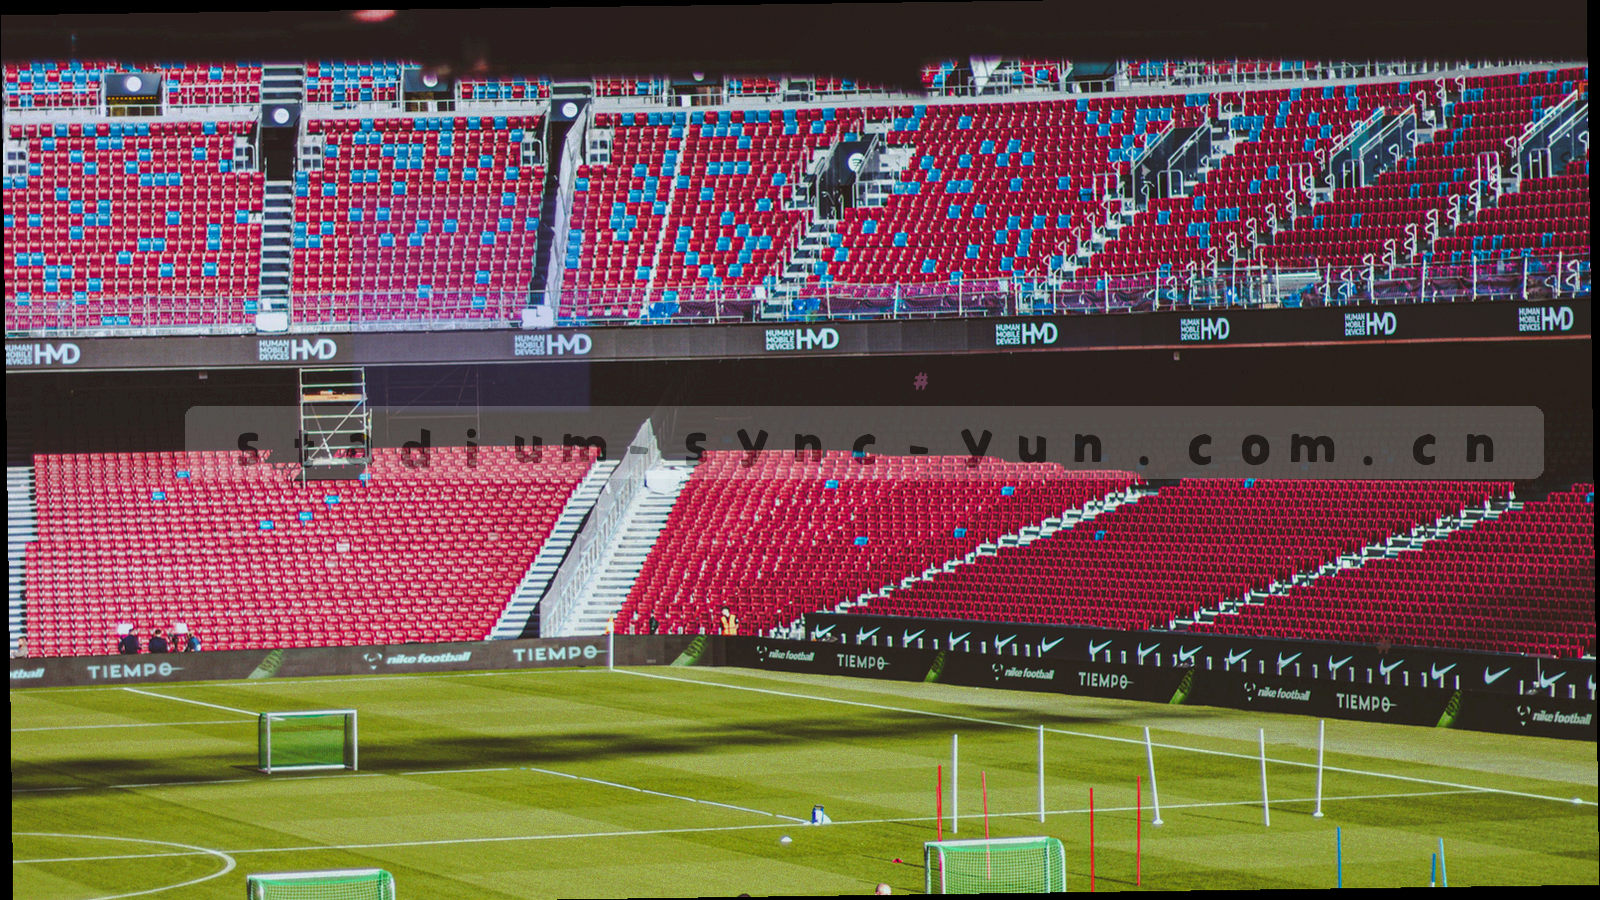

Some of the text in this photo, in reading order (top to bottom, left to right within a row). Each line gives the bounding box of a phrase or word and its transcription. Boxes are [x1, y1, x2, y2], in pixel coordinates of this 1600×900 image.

[1519, 307, 1540, 315] HUMAN
[1519, 315, 1540, 323] MOBILE
[1541, 306, 1574, 331] HMD
[1200, 317, 1231, 340] HMD
[1366, 311, 1398, 335] HMD
[1519, 323, 1541, 331] DEVICES
[796, 327, 840, 350] HMD
[1021, 322, 1059, 344] HMD
[291, 338, 337, 360] HMD
[514, 348, 545, 356] DEVICES
[546, 333, 592, 355] HMD
[765, 343, 795, 351] DEVICES
[34, 343, 81, 365] HMD
[386, 651, 472, 665] nike football
[512, 645, 605, 662] TIEMPO
[768, 649, 815, 662] nike football
[87, 662, 180, 680] TIEMPO
[837, 654, 889, 671] TIEMPO
[1004, 667, 1055, 680] nike football
[1078, 672, 1132, 689] TIEMPO
[1257, 687, 1311, 701] nike football
[1336, 692, 1395, 713] TIEMPO
[1532, 709, 1592, 726] nike football
